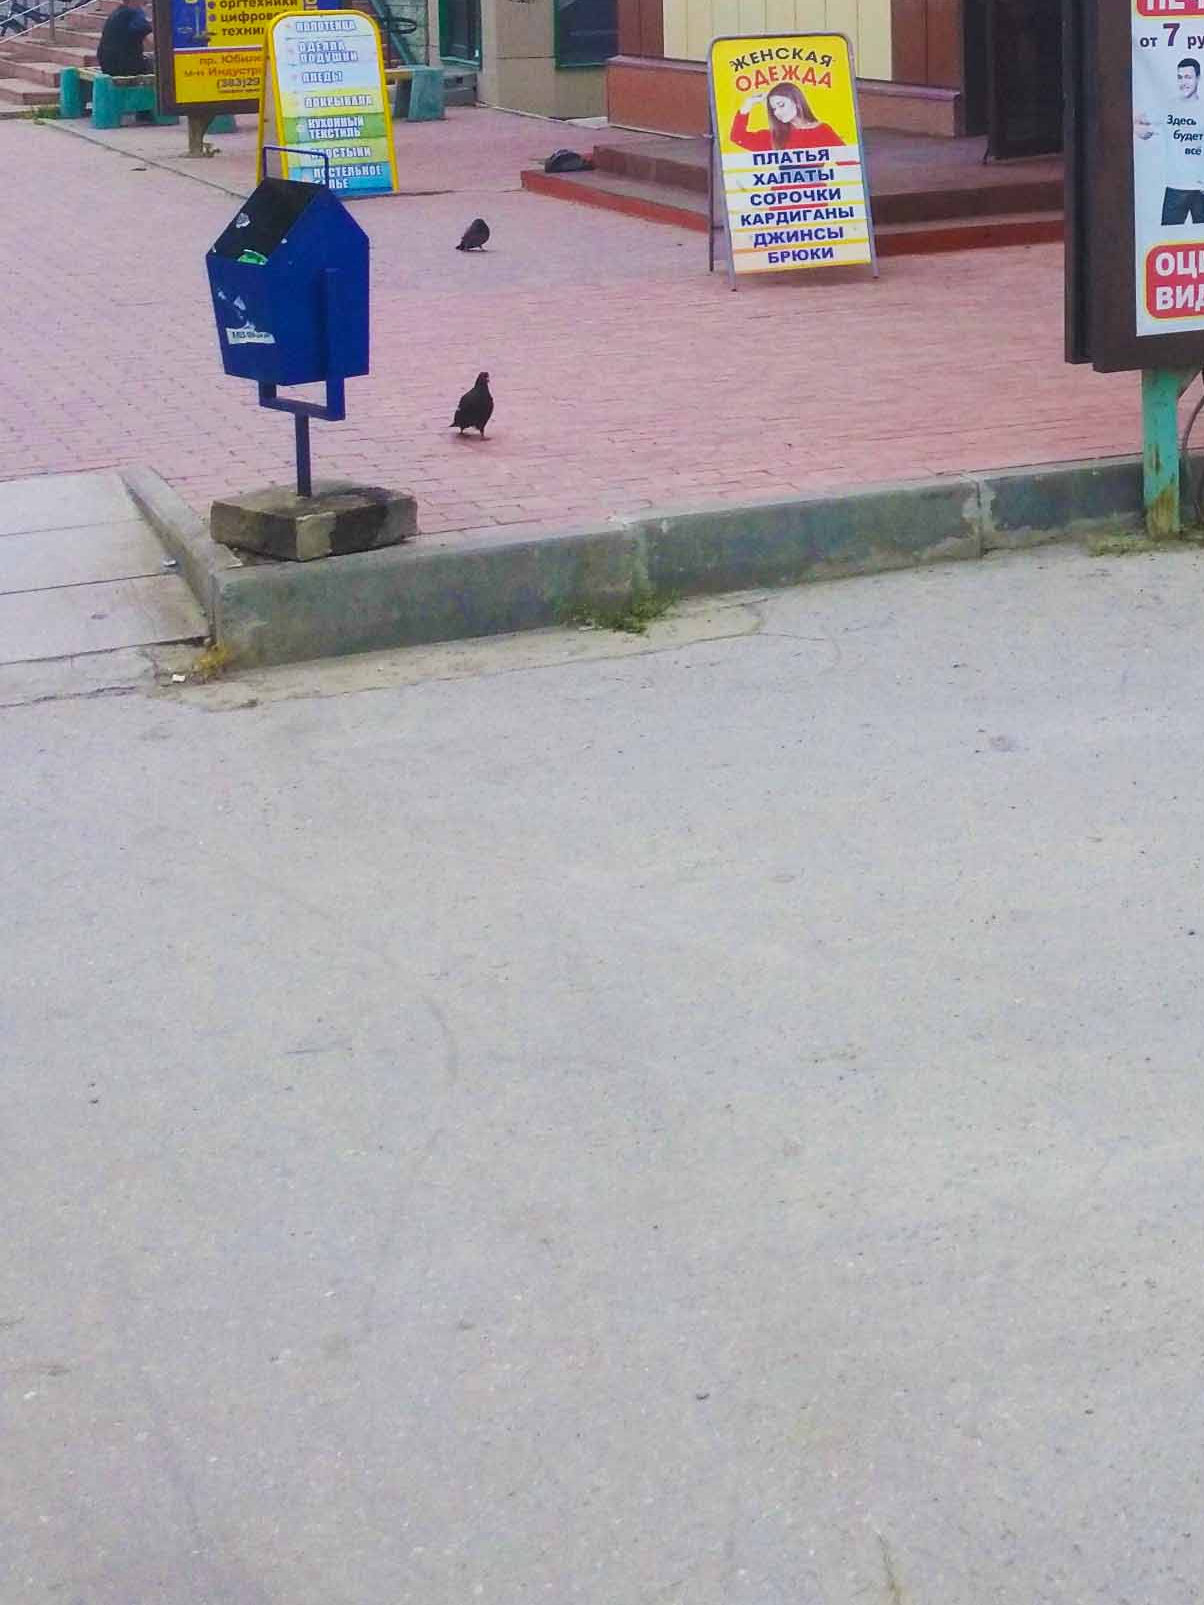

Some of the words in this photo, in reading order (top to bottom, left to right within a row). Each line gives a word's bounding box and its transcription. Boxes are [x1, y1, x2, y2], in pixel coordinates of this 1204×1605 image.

[221, 11, 280, 23] цифров
[1139, 35, 1158, 48] от
[1163, 23, 1181, 47] 7
[221, 54, 262, 65] Юбиле
[300, 50, 358, 64] ПОДУШКИ
[730, 47, 834, 72] ЖЕНСКАЯ
[302, 70, 343, 84] ПЛЕДЫ
[735, 64, 832, 92] ОДЕЖДА
[308, 115, 364, 129] КУХОННЫЙ
[1167, 114, 1197, 126] Здесь
[308, 127, 361, 139] ТЕКСТИЛЬ
[1173, 129, 1204, 142] будет
[752, 149, 830, 166] ПЛАТЬЯ
[752, 169, 835, 186] ХАЛАТЫ
[750, 188, 841, 207] СОРОЧКИ
[741, 207, 854, 226] КАРДИГАНЫ
[753, 227, 844, 248] ДЖИНСЫ
[767, 247, 834, 264] БРЮКИ
